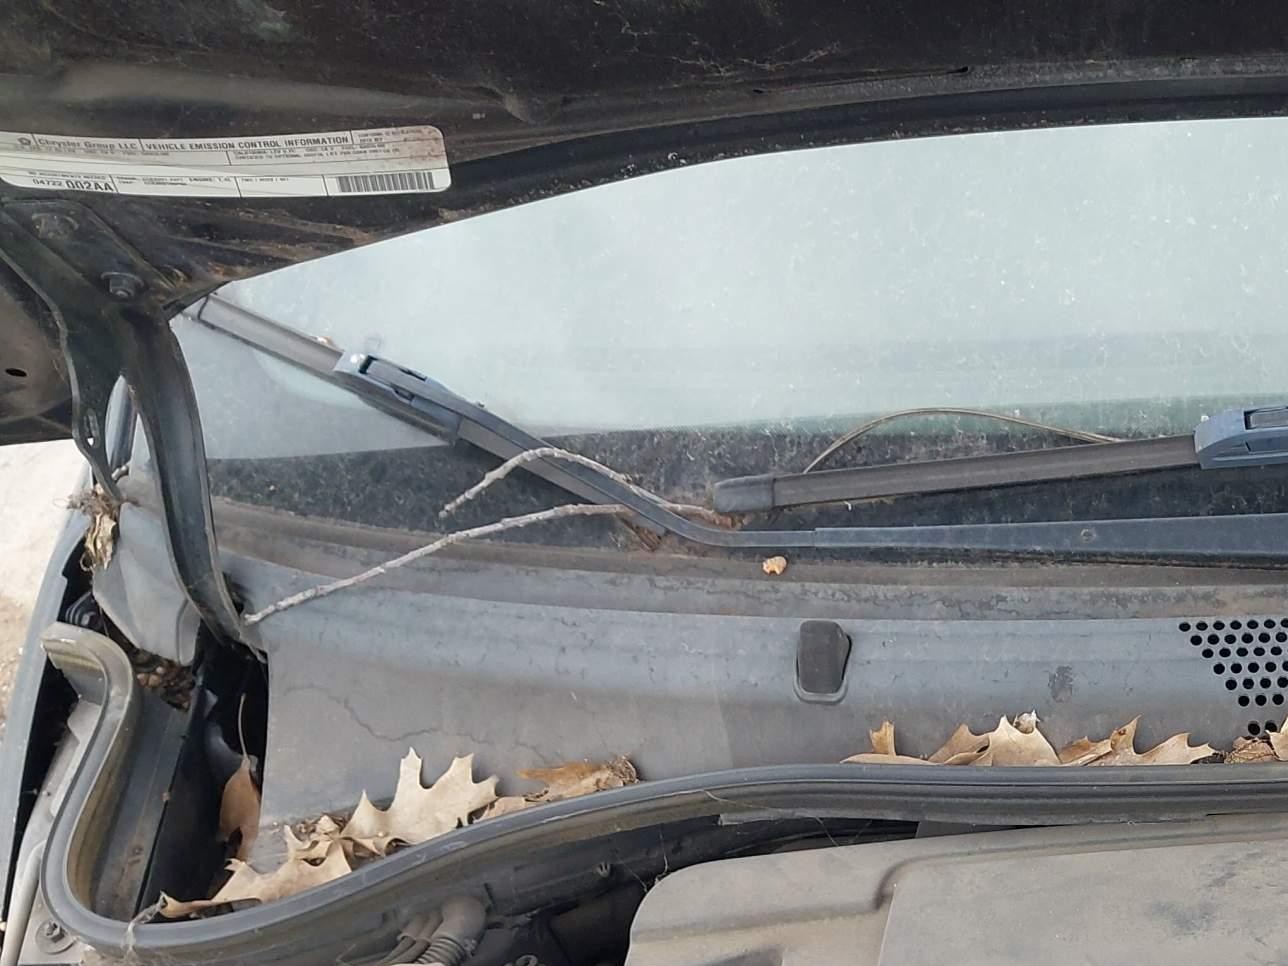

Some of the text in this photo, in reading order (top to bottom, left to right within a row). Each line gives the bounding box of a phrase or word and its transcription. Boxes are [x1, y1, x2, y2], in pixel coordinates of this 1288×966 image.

[39, 138, 81, 147] Chrysler
[84, 141, 115, 150] Group
[189, 142, 235, 150] EMISSION
[238, 140, 280, 148] CONTROL
[285, 136, 349, 146] INFORMATION
[65, 180, 114, 192] 002AA
